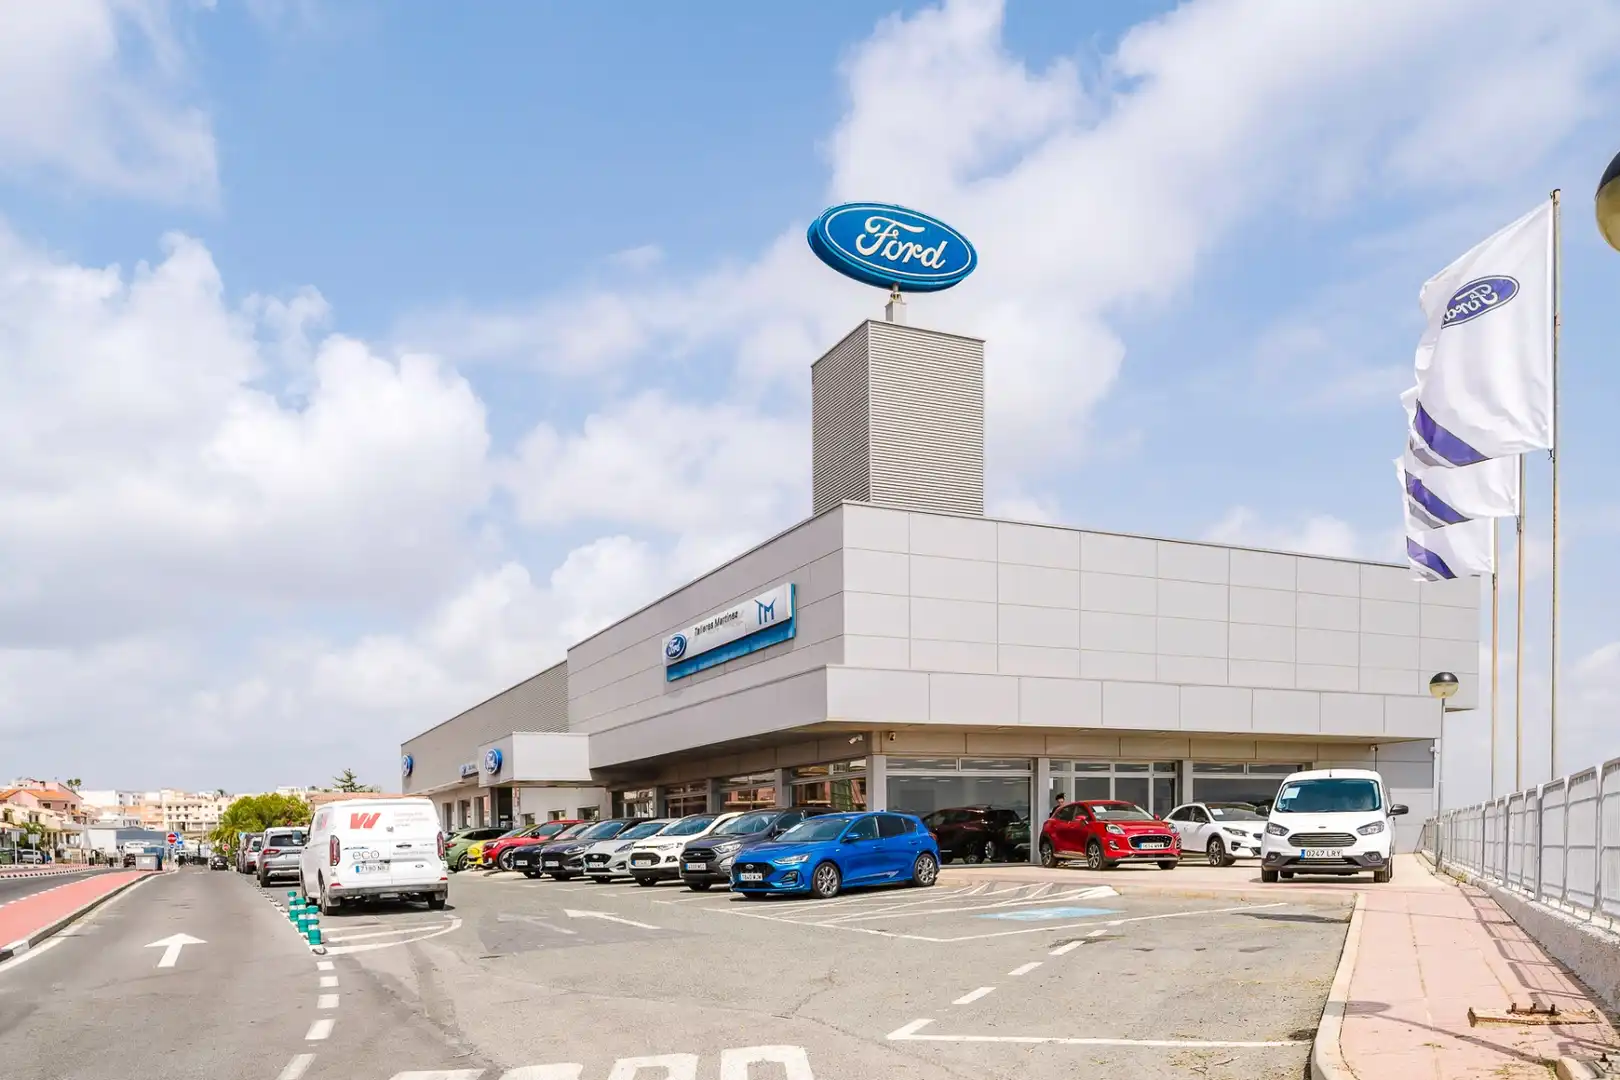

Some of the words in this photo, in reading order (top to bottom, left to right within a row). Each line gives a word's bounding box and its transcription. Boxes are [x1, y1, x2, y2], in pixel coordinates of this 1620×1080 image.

[855, 216, 948, 269] Ford
[352, 850, 380, 860] eco
[1306, 849, 1325, 857] 0247
[1326, 849, 1341, 857] LRY
